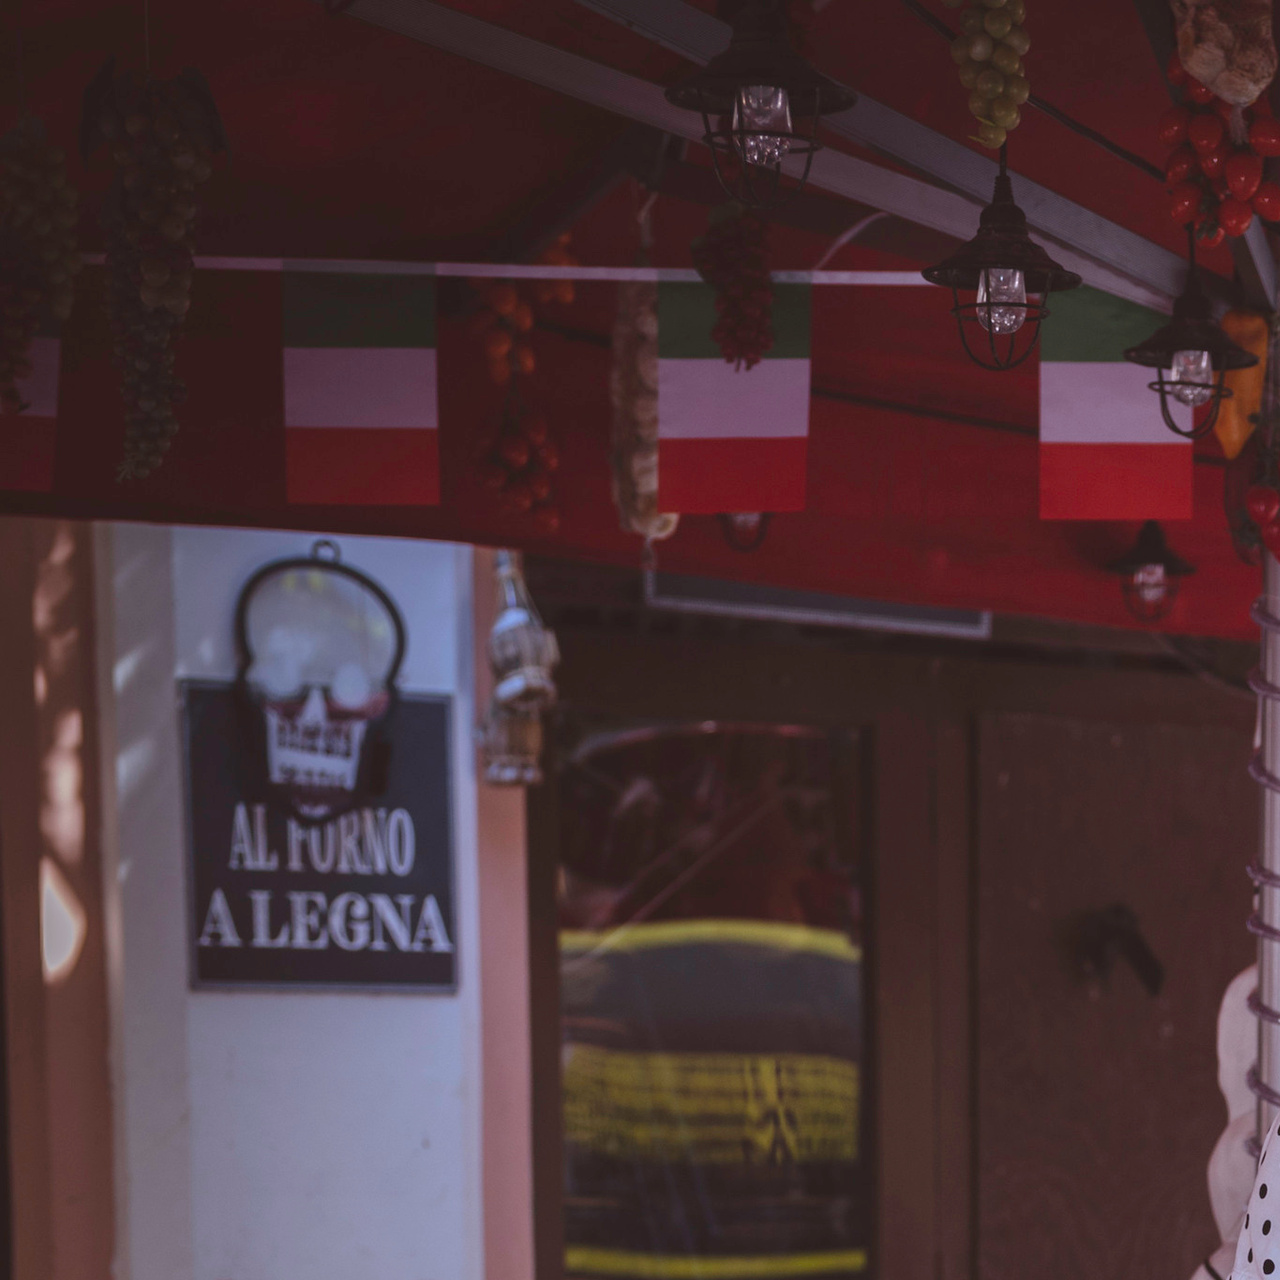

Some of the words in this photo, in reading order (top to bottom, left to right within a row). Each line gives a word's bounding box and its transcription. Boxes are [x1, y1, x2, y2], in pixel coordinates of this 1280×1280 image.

[228, 802, 279, 872] AL
[197, 887, 241, 949] A
[248, 889, 455, 954] LEGNA
